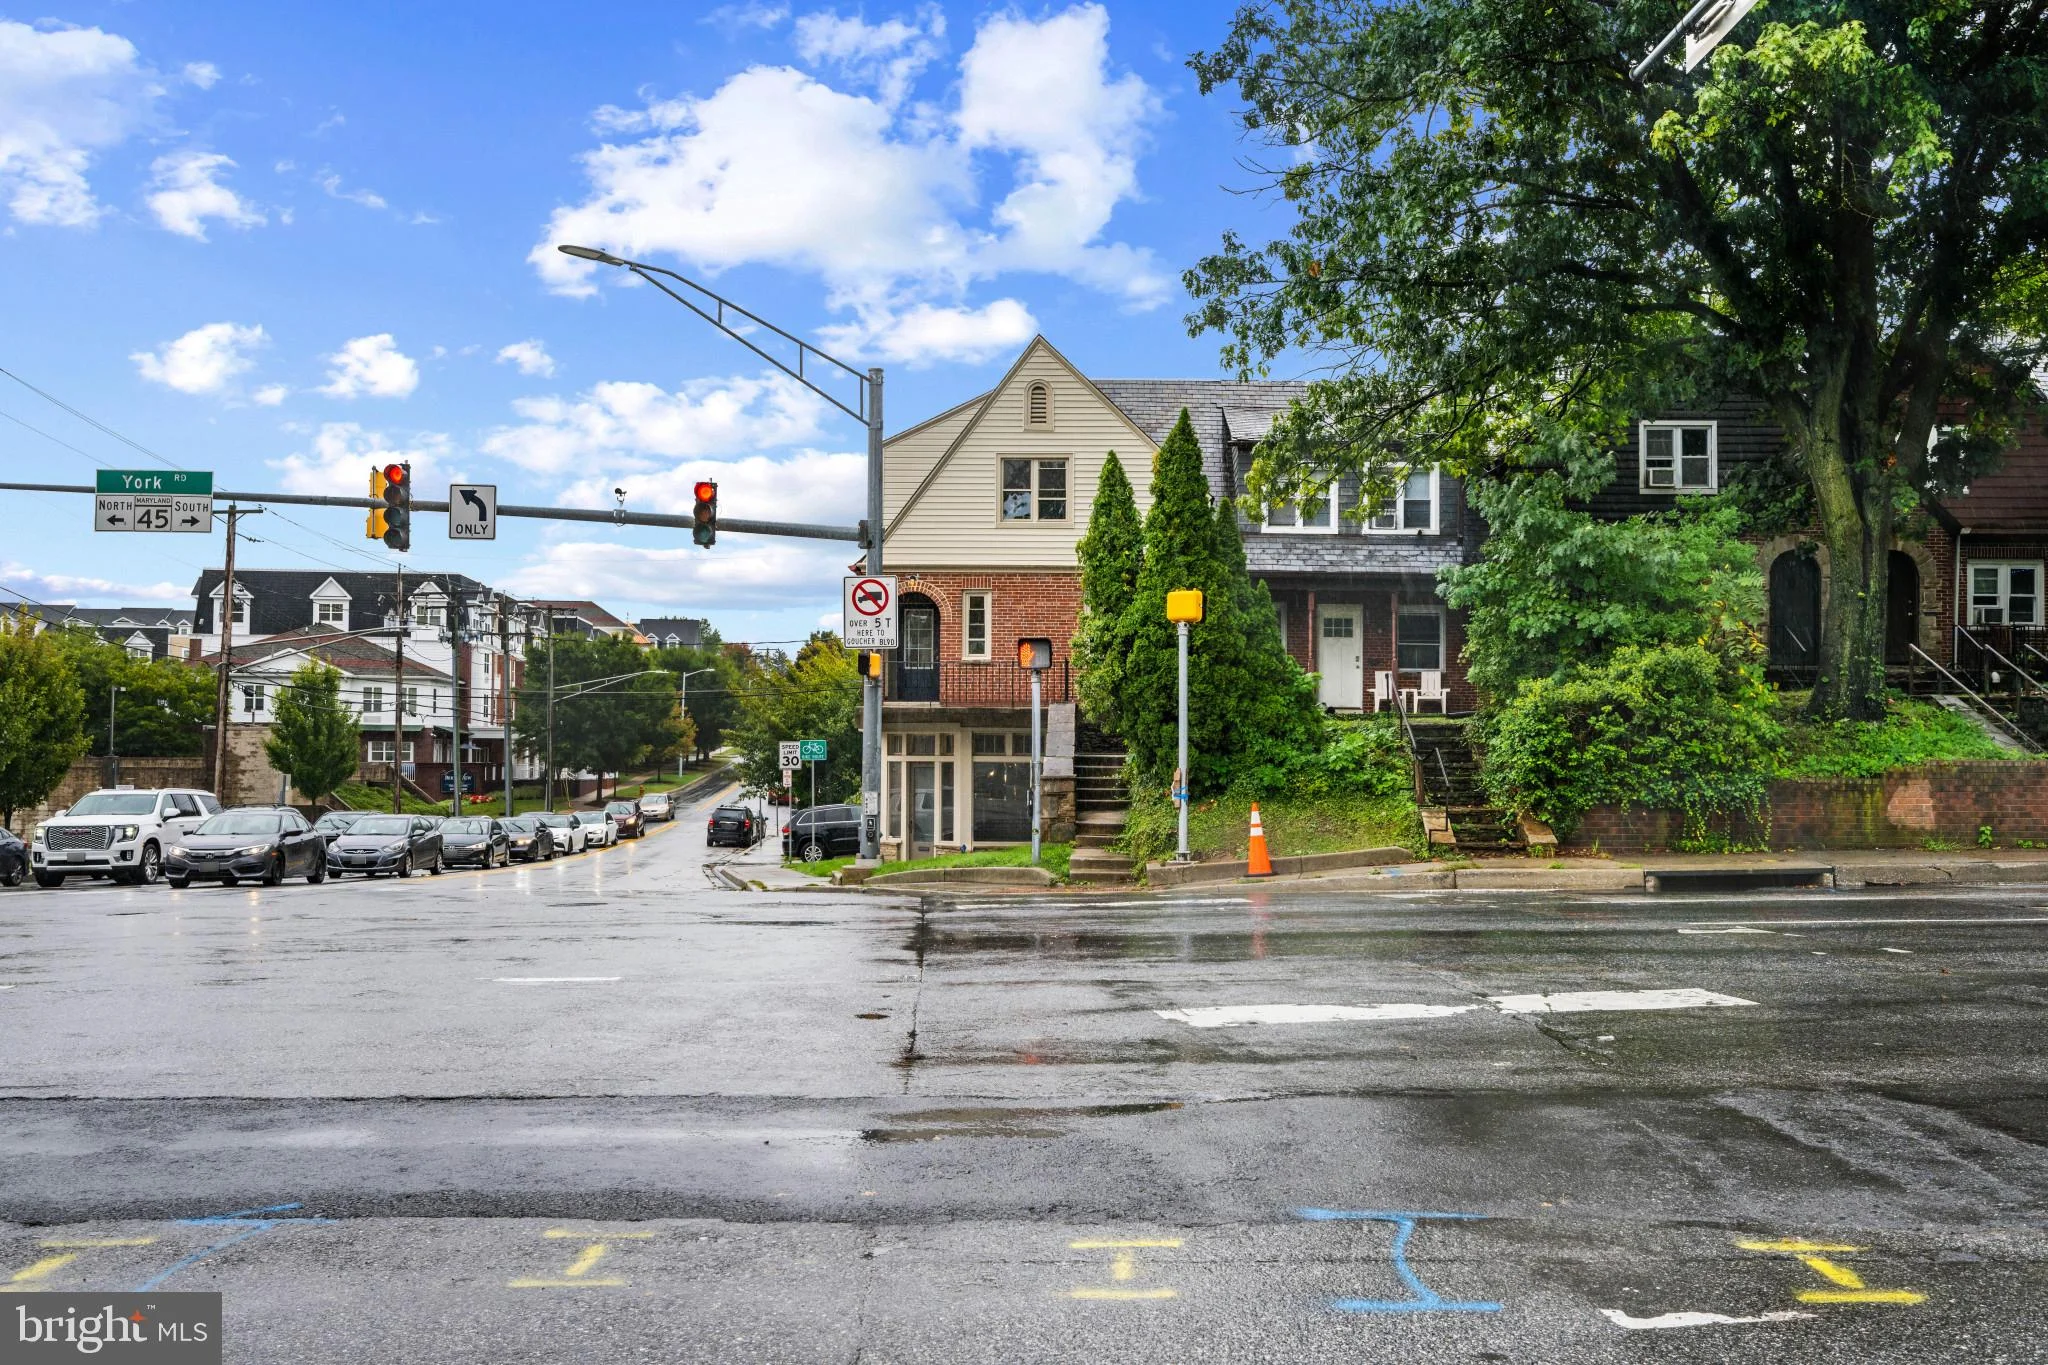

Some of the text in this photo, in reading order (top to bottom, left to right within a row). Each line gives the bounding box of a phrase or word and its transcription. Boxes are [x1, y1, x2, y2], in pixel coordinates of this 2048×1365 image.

[122, 474, 187, 489] York RD
[99, 499, 132, 511] NORTH
[174, 501, 209, 512] SOUTH
[137, 509, 169, 529] 45
[456, 524, 488, 535] ONLY
[849, 617, 891, 628] OVER 5 T
[847, 638, 895, 646] GOUCHER BLVD
[782, 755, 800, 767] 30
